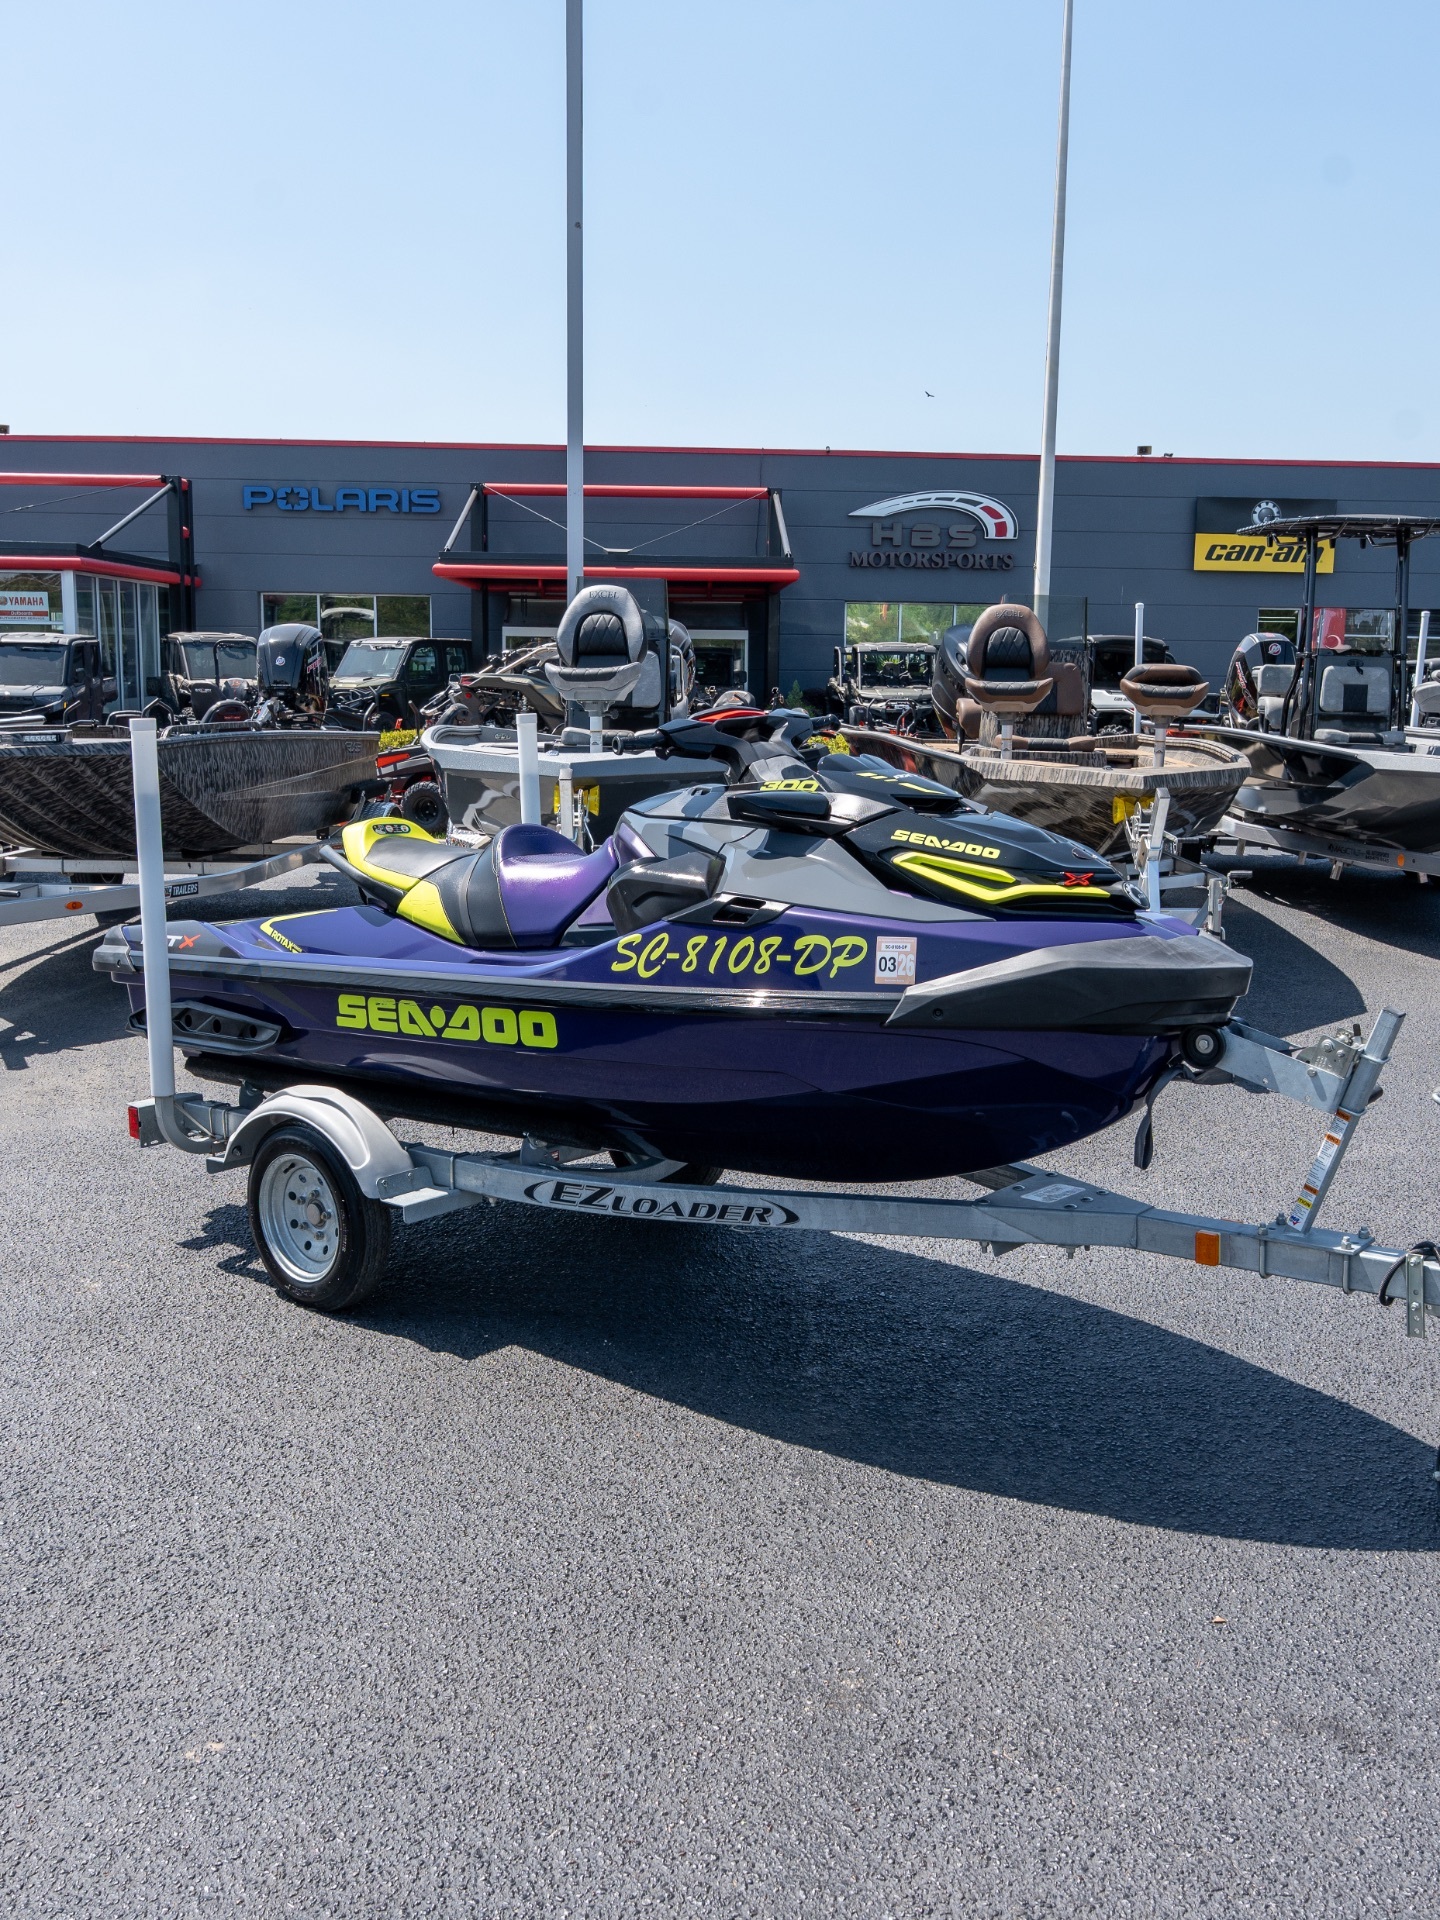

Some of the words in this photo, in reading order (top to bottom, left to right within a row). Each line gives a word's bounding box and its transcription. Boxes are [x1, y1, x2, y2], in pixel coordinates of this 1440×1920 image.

[243, 486, 441, 513] POLARIS
[872, 522, 977, 548] HBS
[849, 551, 1015, 570] MOTORSPORTS
[9, 596, 44, 606] YAMAHA
[589, 590, 620, 599] EXCEL
[994, 609, 1024, 619] EXCEL
[760, 780, 819, 793] 300
[172, 884, 198, 896] TRAILERS
[271, 929, 294, 951] ROTAX
[611, 932, 868, 978] SC-8108-DP
[878, 956, 897, 972] 03
[897, 953, 916, 977] 26
